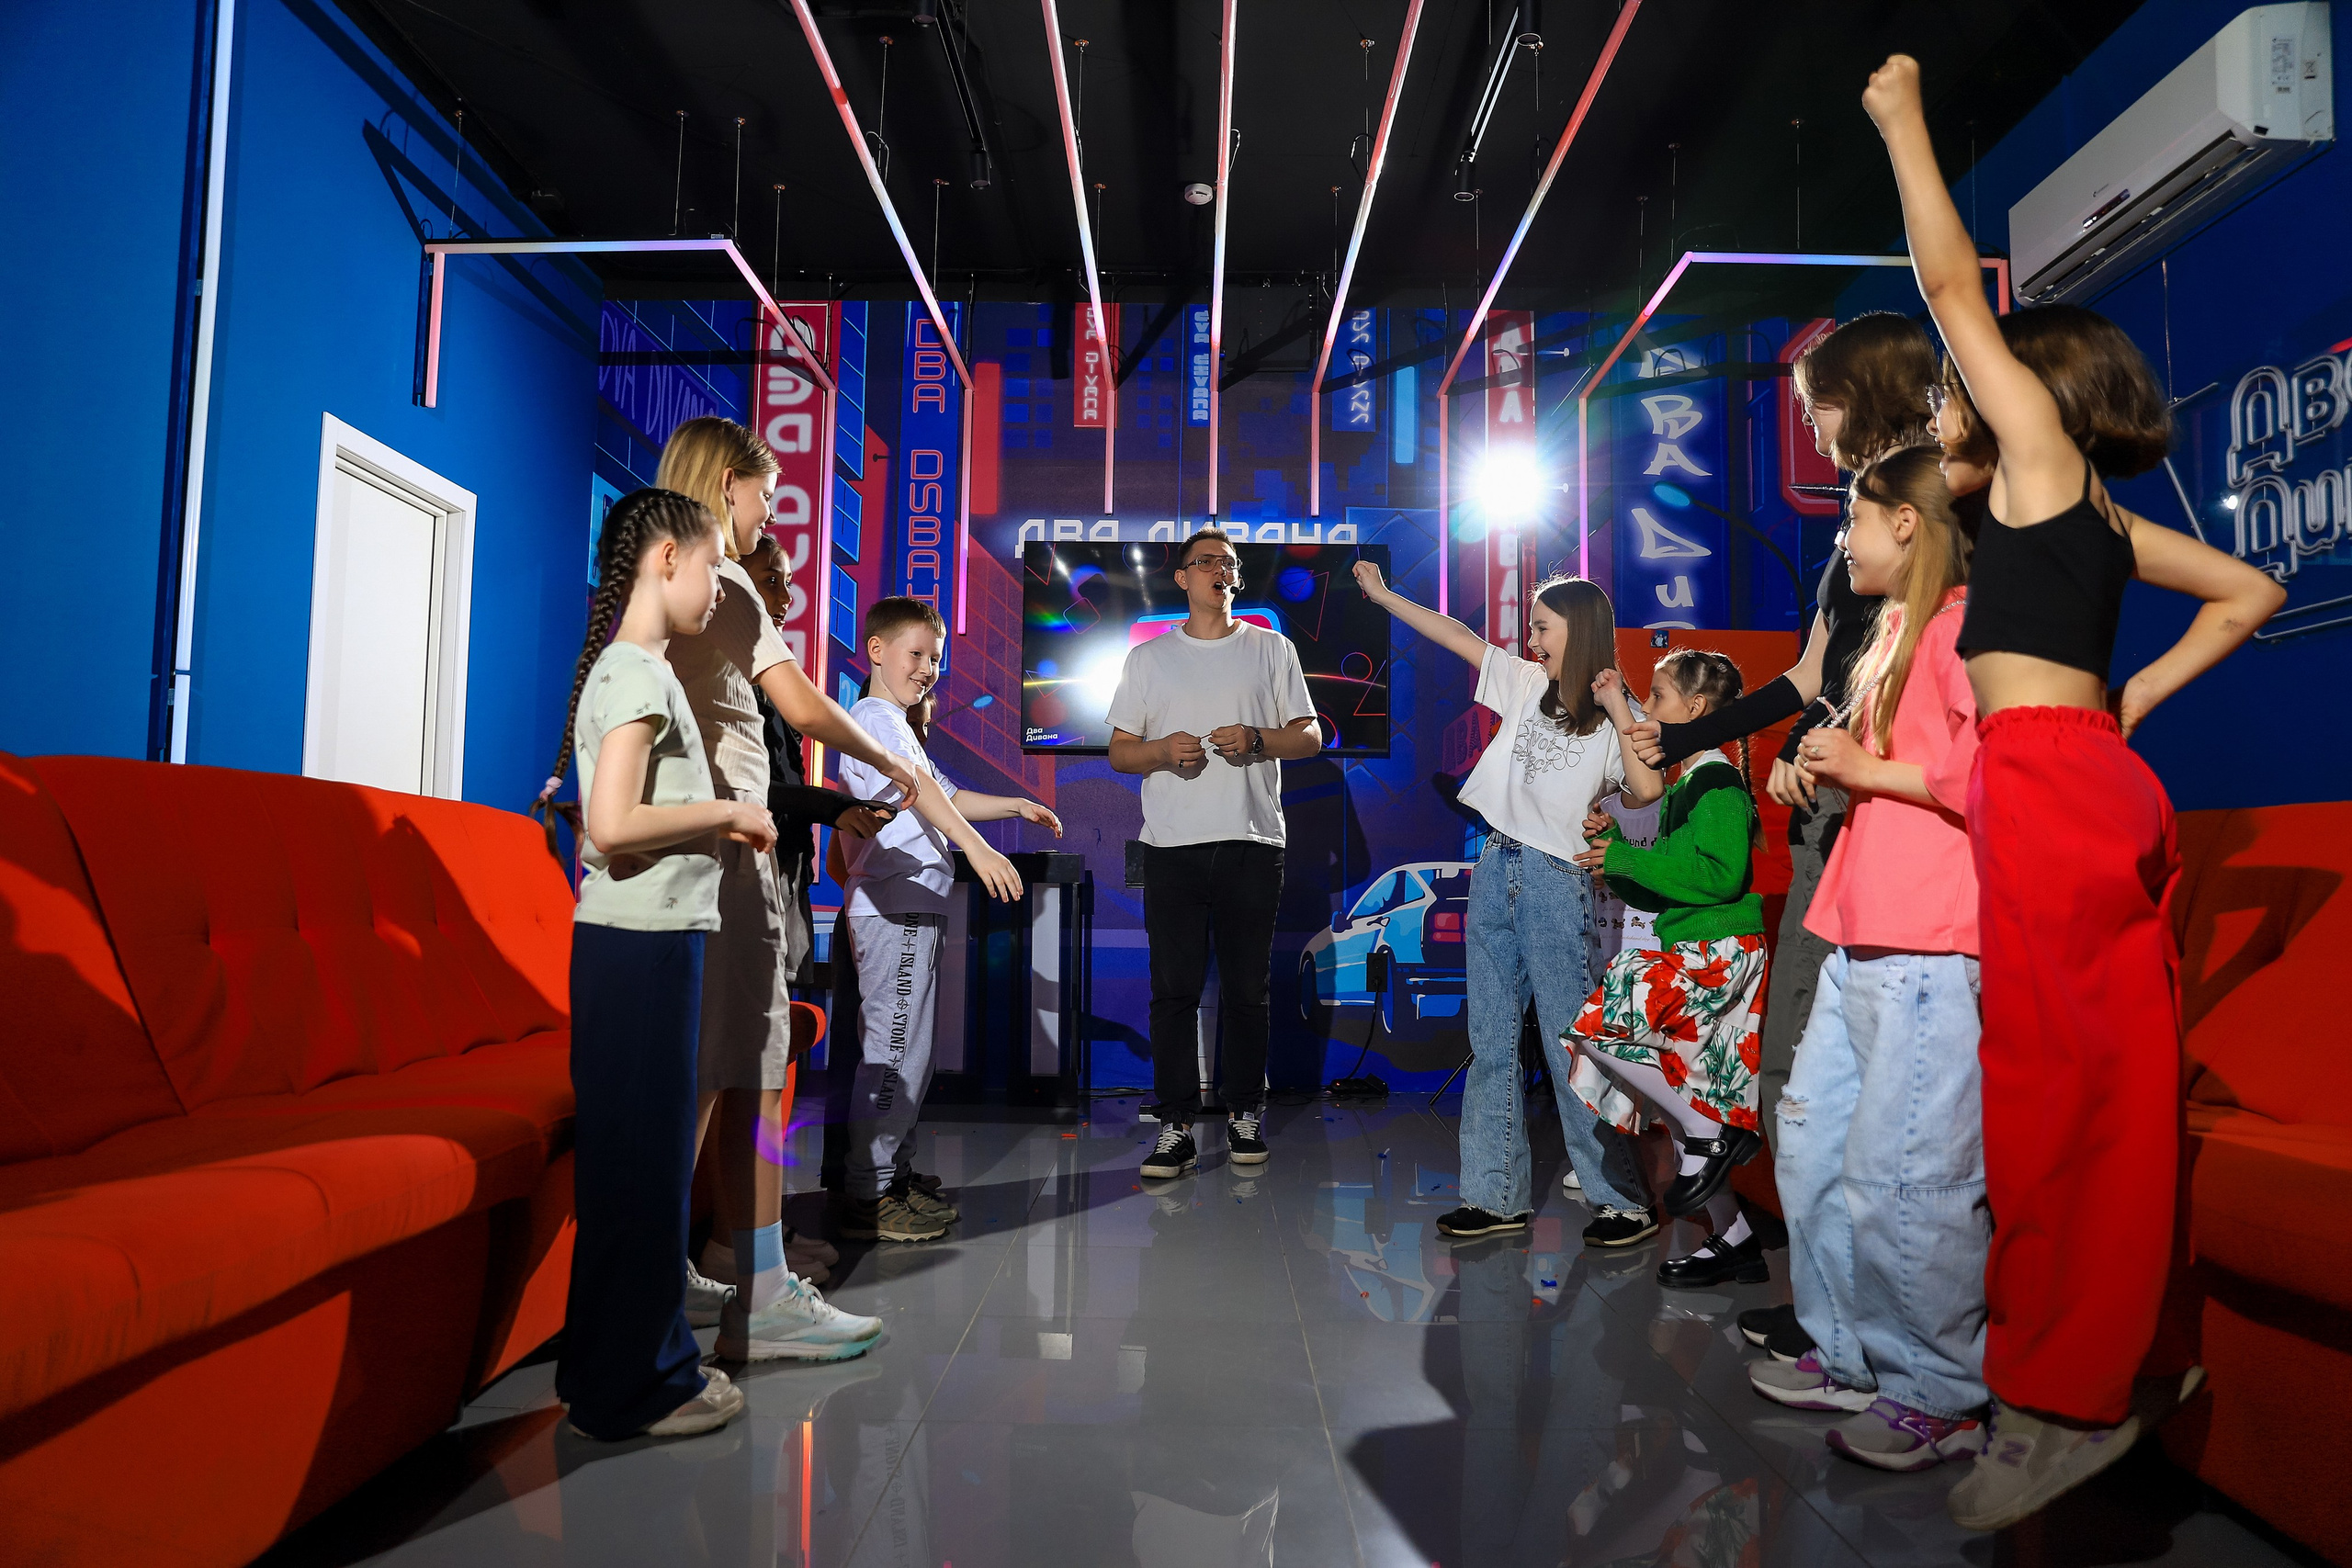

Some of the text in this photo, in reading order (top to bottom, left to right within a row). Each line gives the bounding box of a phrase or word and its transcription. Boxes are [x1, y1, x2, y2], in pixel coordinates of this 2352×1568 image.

[1025, 728, 1044, 736] Два
[1025, 733, 1058, 742] Дивана
[896, 952, 915, 997] ISLAND
[889, 1012, 908, 1055] STONE
[876, 1067, 899, 1111] ISLAND
